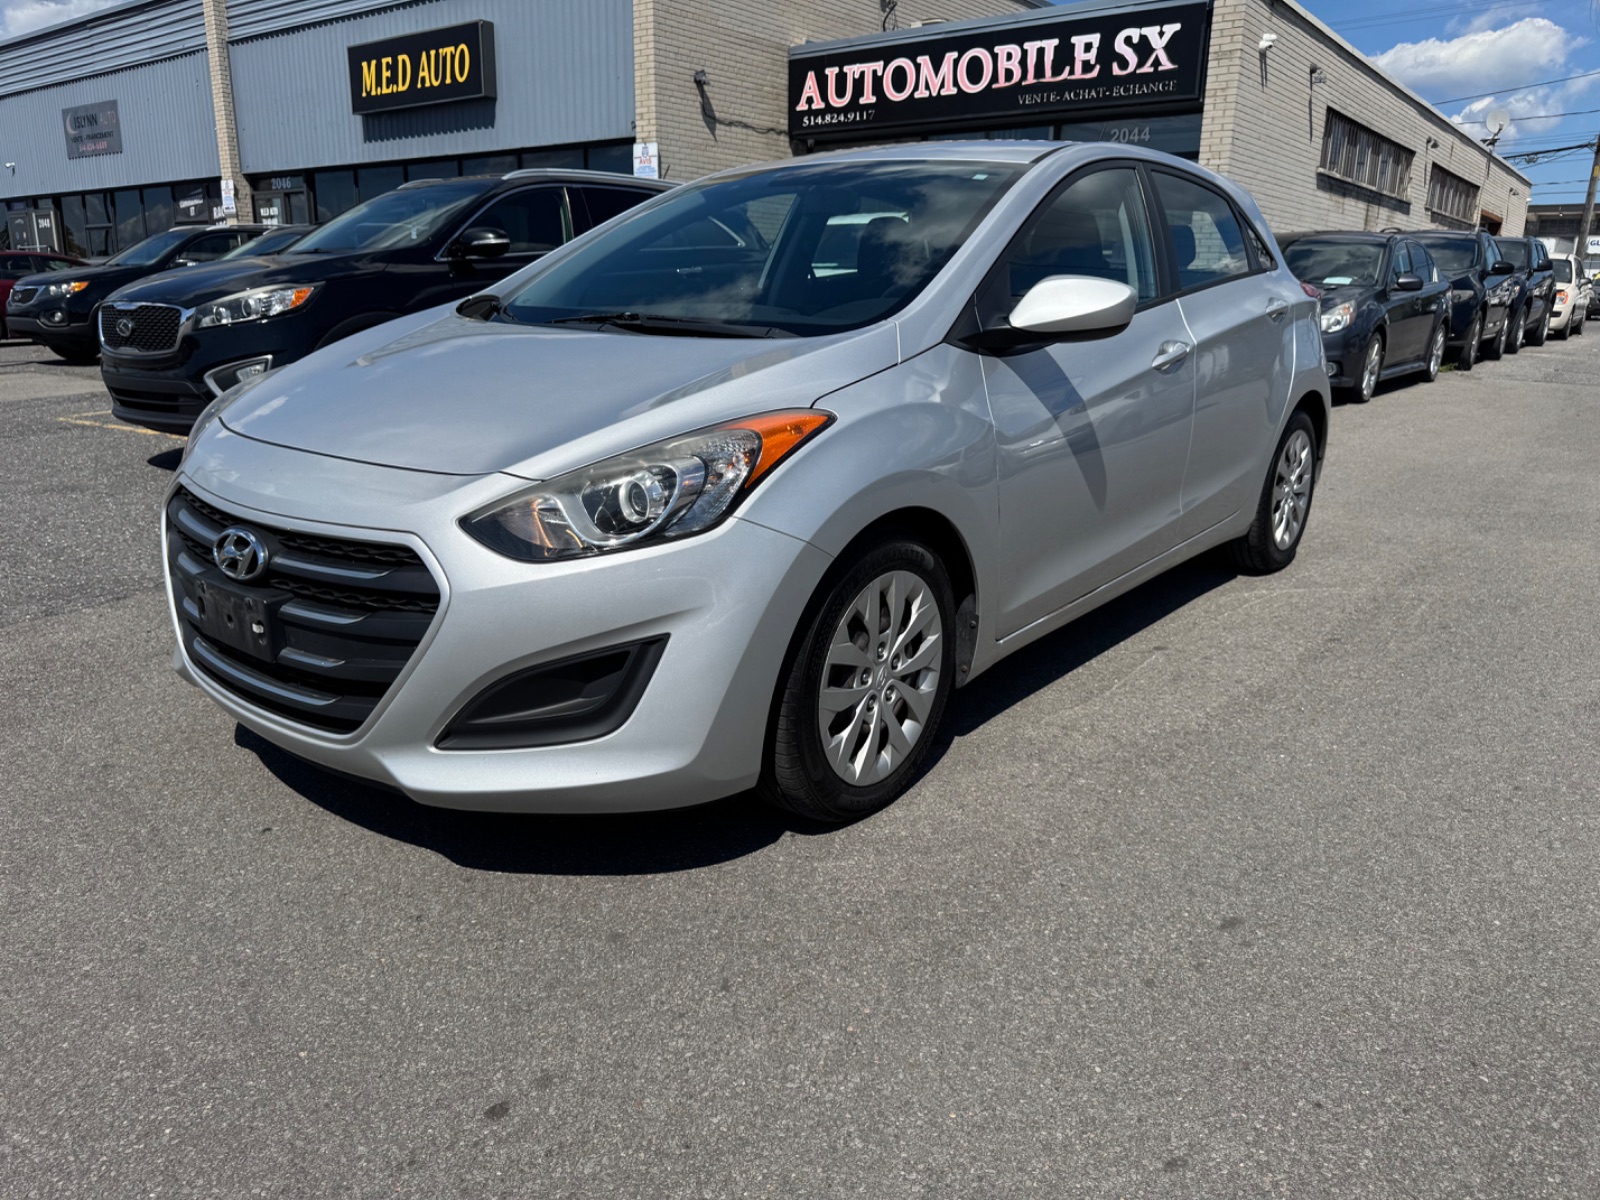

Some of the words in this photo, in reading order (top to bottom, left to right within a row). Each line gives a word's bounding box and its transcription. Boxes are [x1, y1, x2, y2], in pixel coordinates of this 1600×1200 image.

[362, 54, 411, 97] M.E.D
[417, 43, 470, 88] AUTO
[796, 33, 1100, 111] AUTOMOBILE
[1112, 23, 1181, 76] SX
[802, 110, 875, 127] 514.824.9117
[1110, 126, 1150, 144] 2044
[271, 176, 291, 190] 2046
